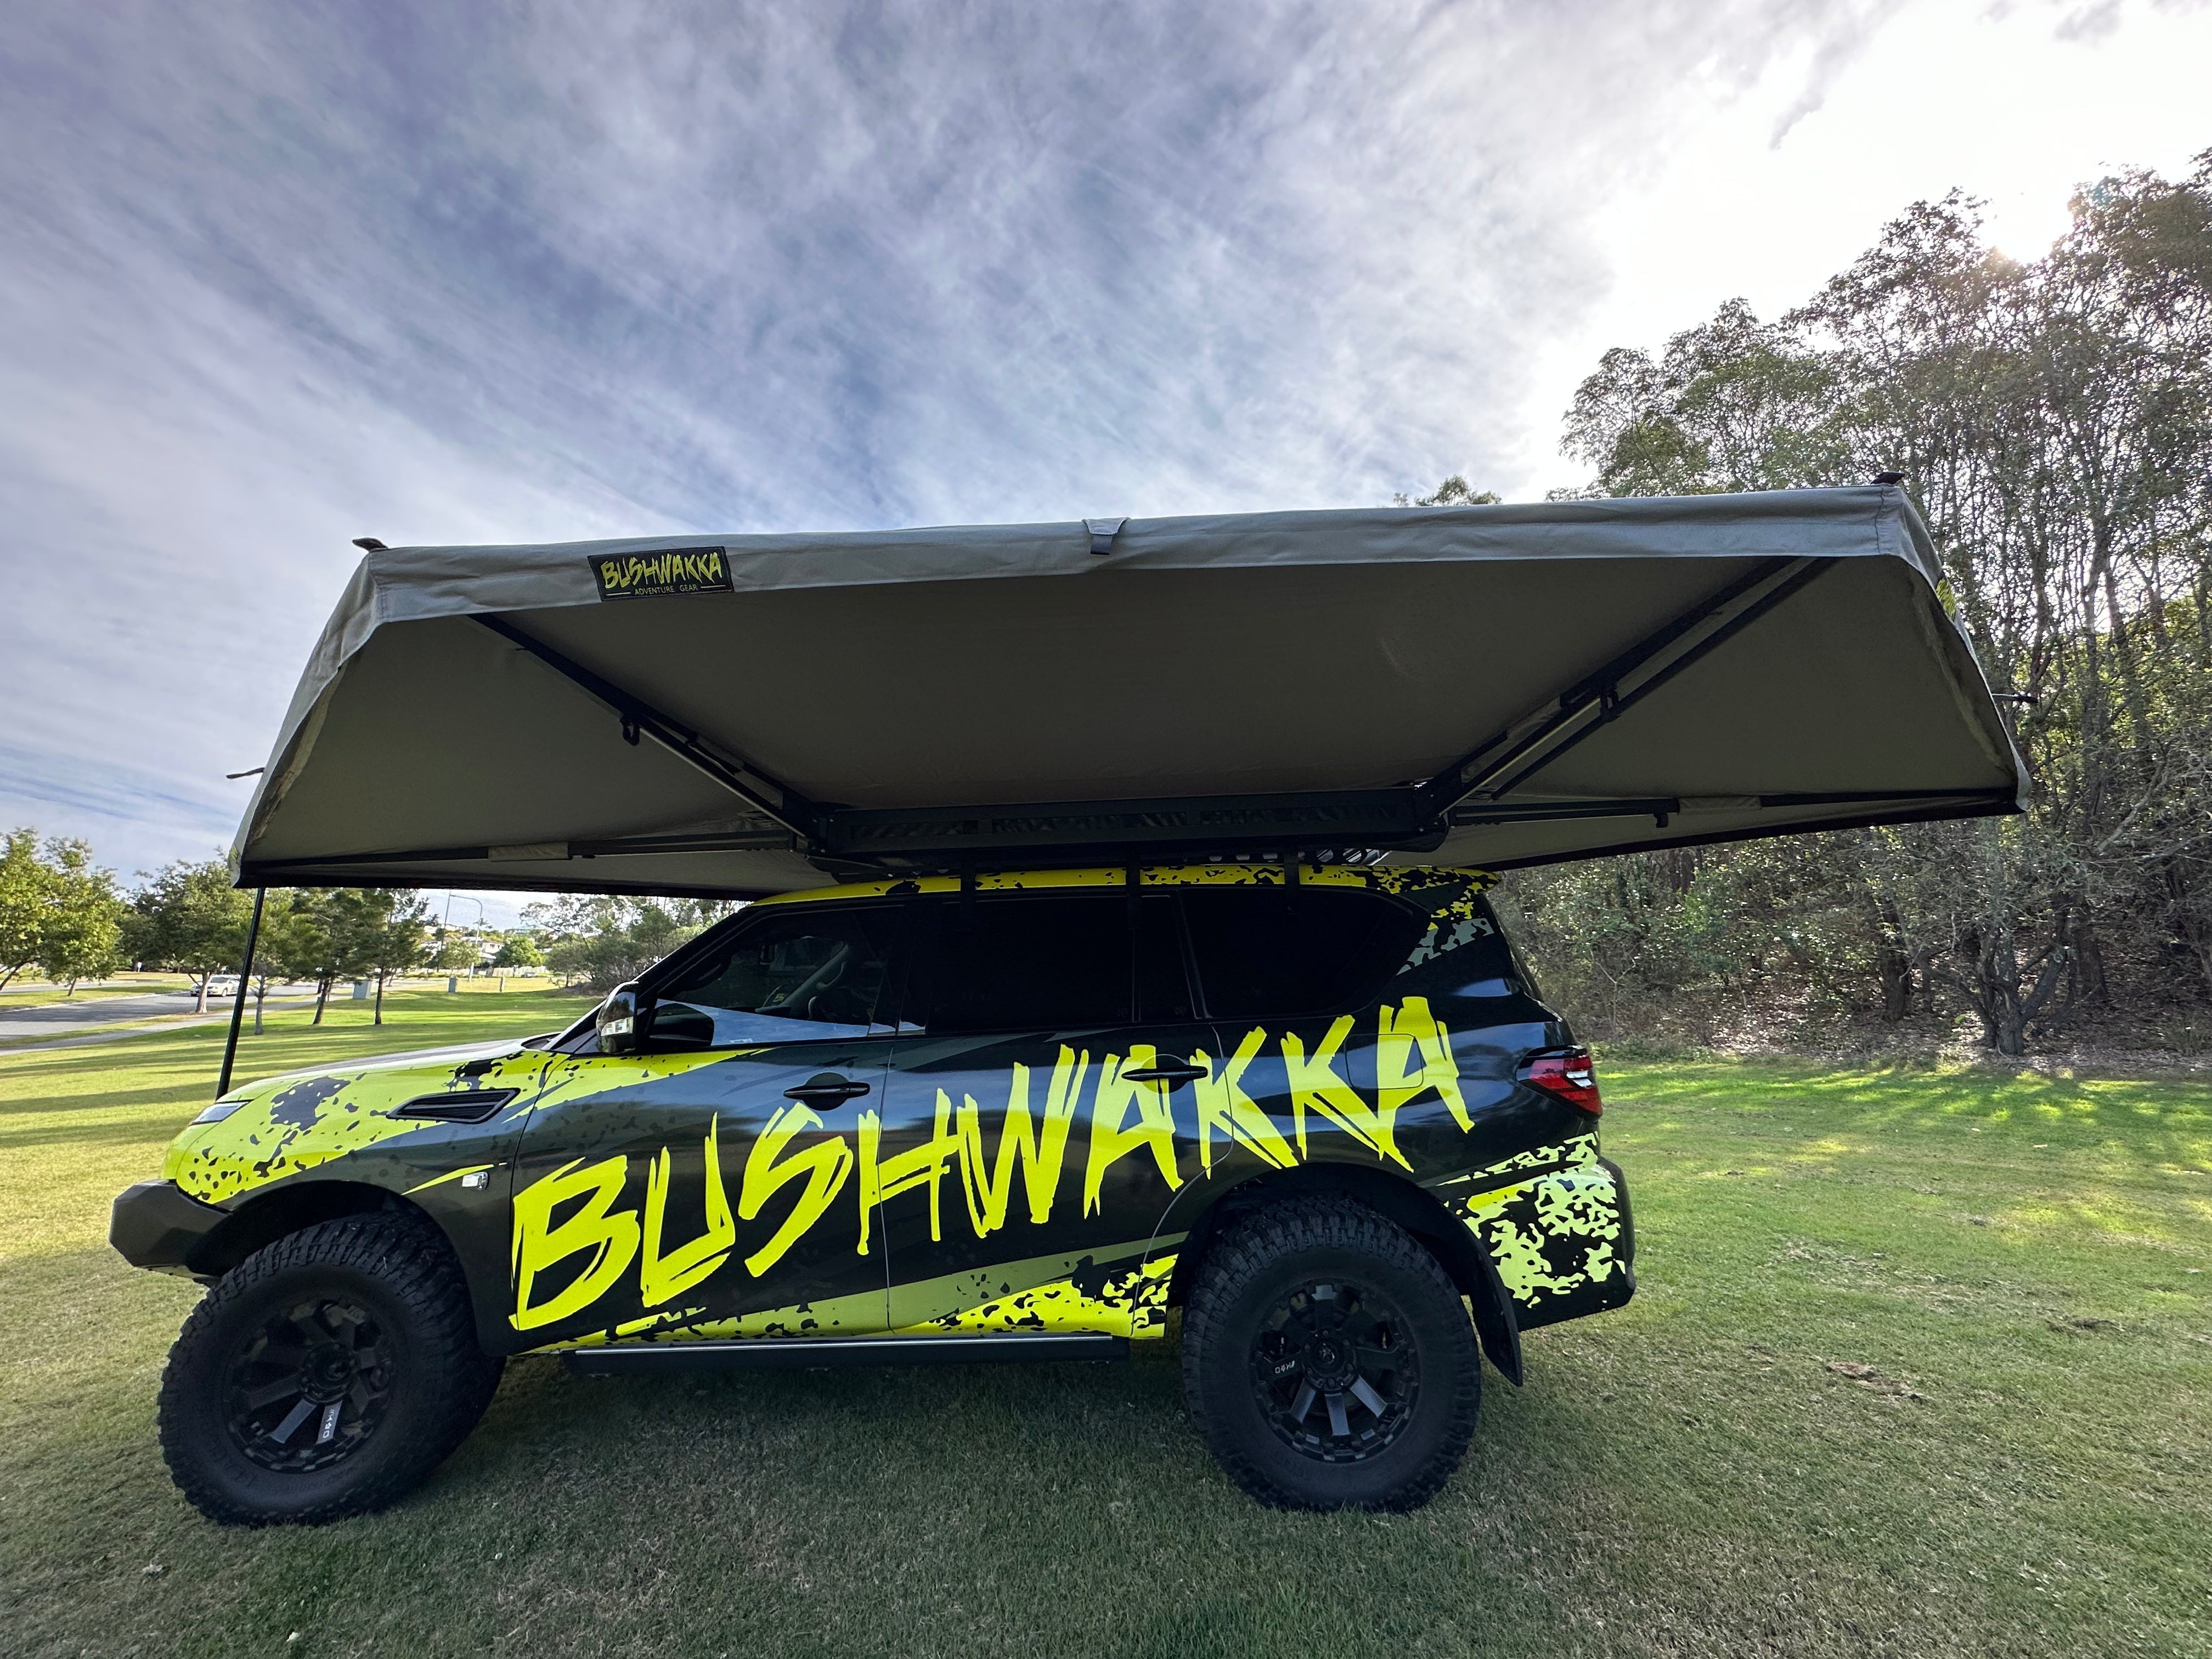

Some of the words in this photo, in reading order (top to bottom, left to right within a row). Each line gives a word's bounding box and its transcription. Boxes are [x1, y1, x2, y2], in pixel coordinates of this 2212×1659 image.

[601, 552, 723, 589] BUSHWAKKA
[635, 586, 675, 596] ADVENTURE
[680, 584, 698, 592] GEAR
[509, 996, 1474, 1331] BUSHWAKKA
